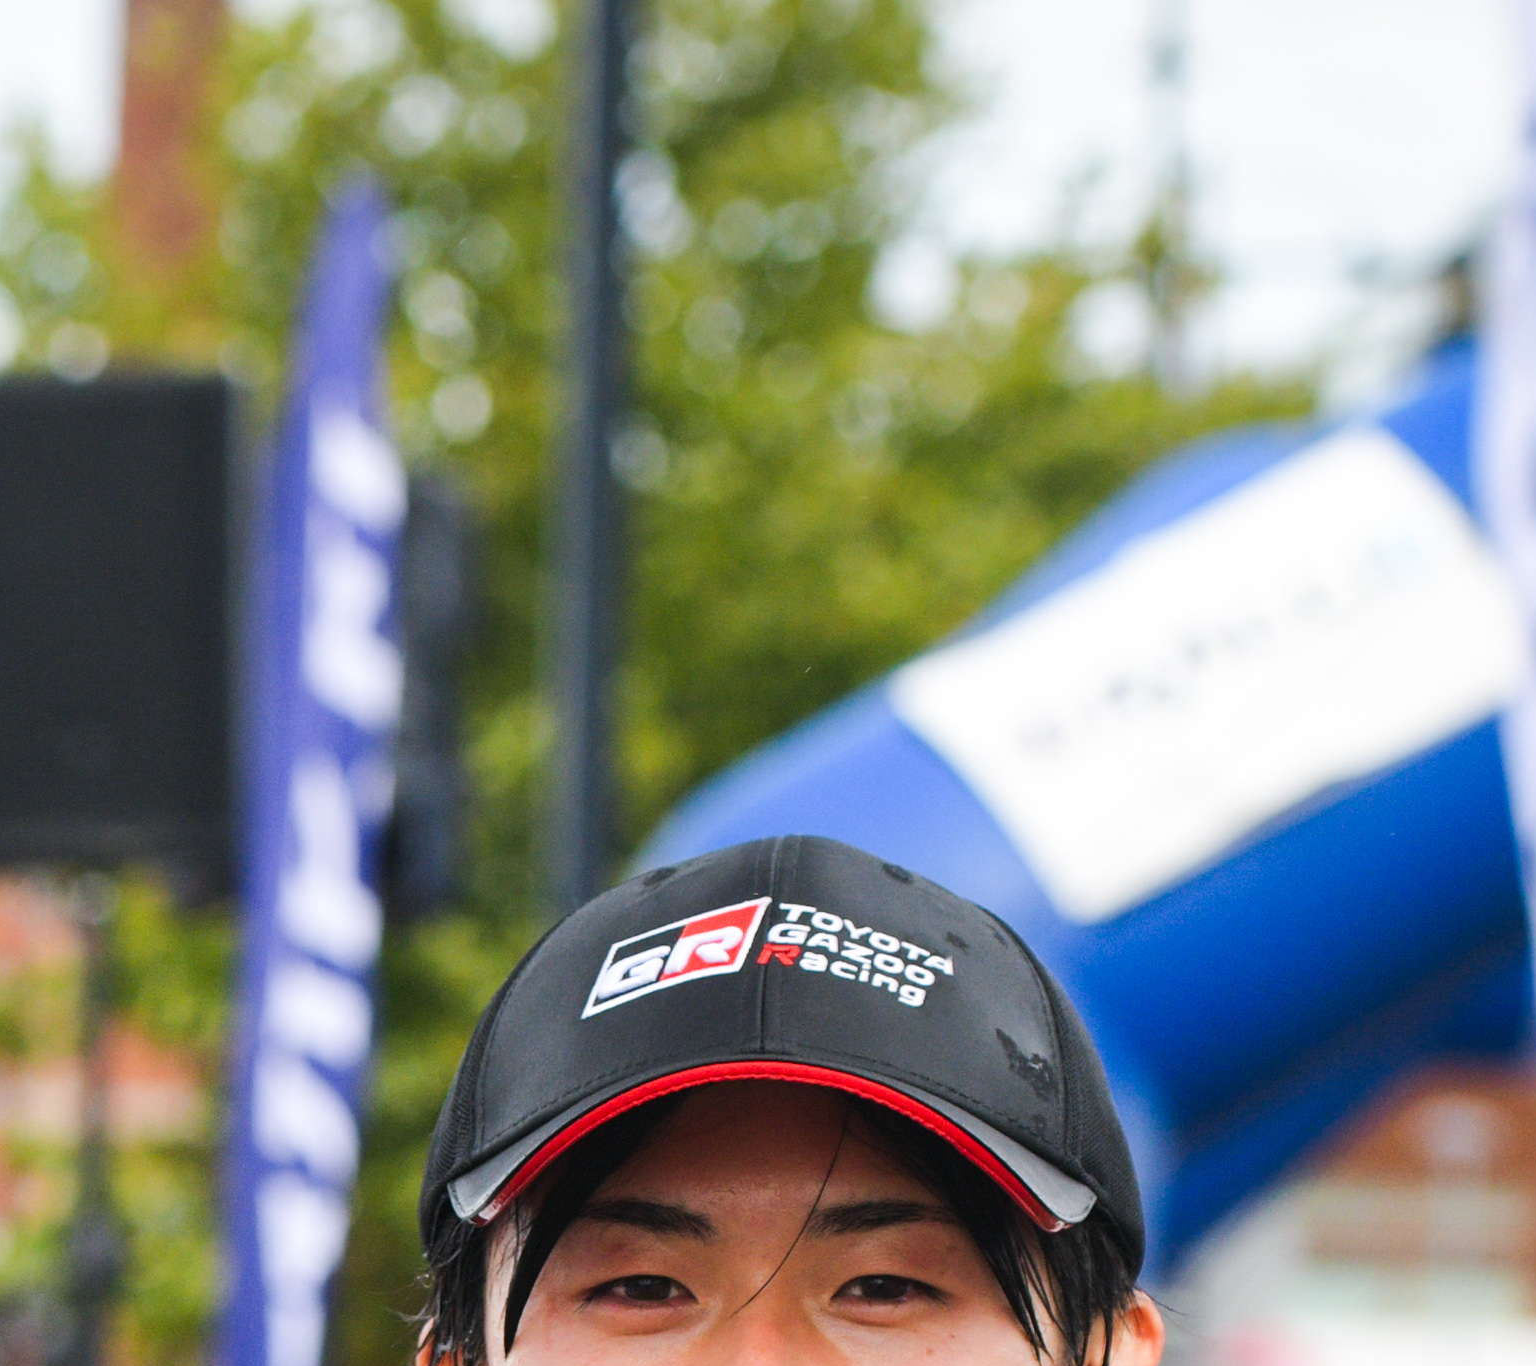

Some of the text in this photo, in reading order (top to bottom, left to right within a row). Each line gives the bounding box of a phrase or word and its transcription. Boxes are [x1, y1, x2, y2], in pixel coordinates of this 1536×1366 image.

[596, 925, 743, 1001] GR
[766, 923, 936, 987] GAZOO
[779, 902, 954, 977] TOYOTA
[757, 943, 926, 1008] Racing
